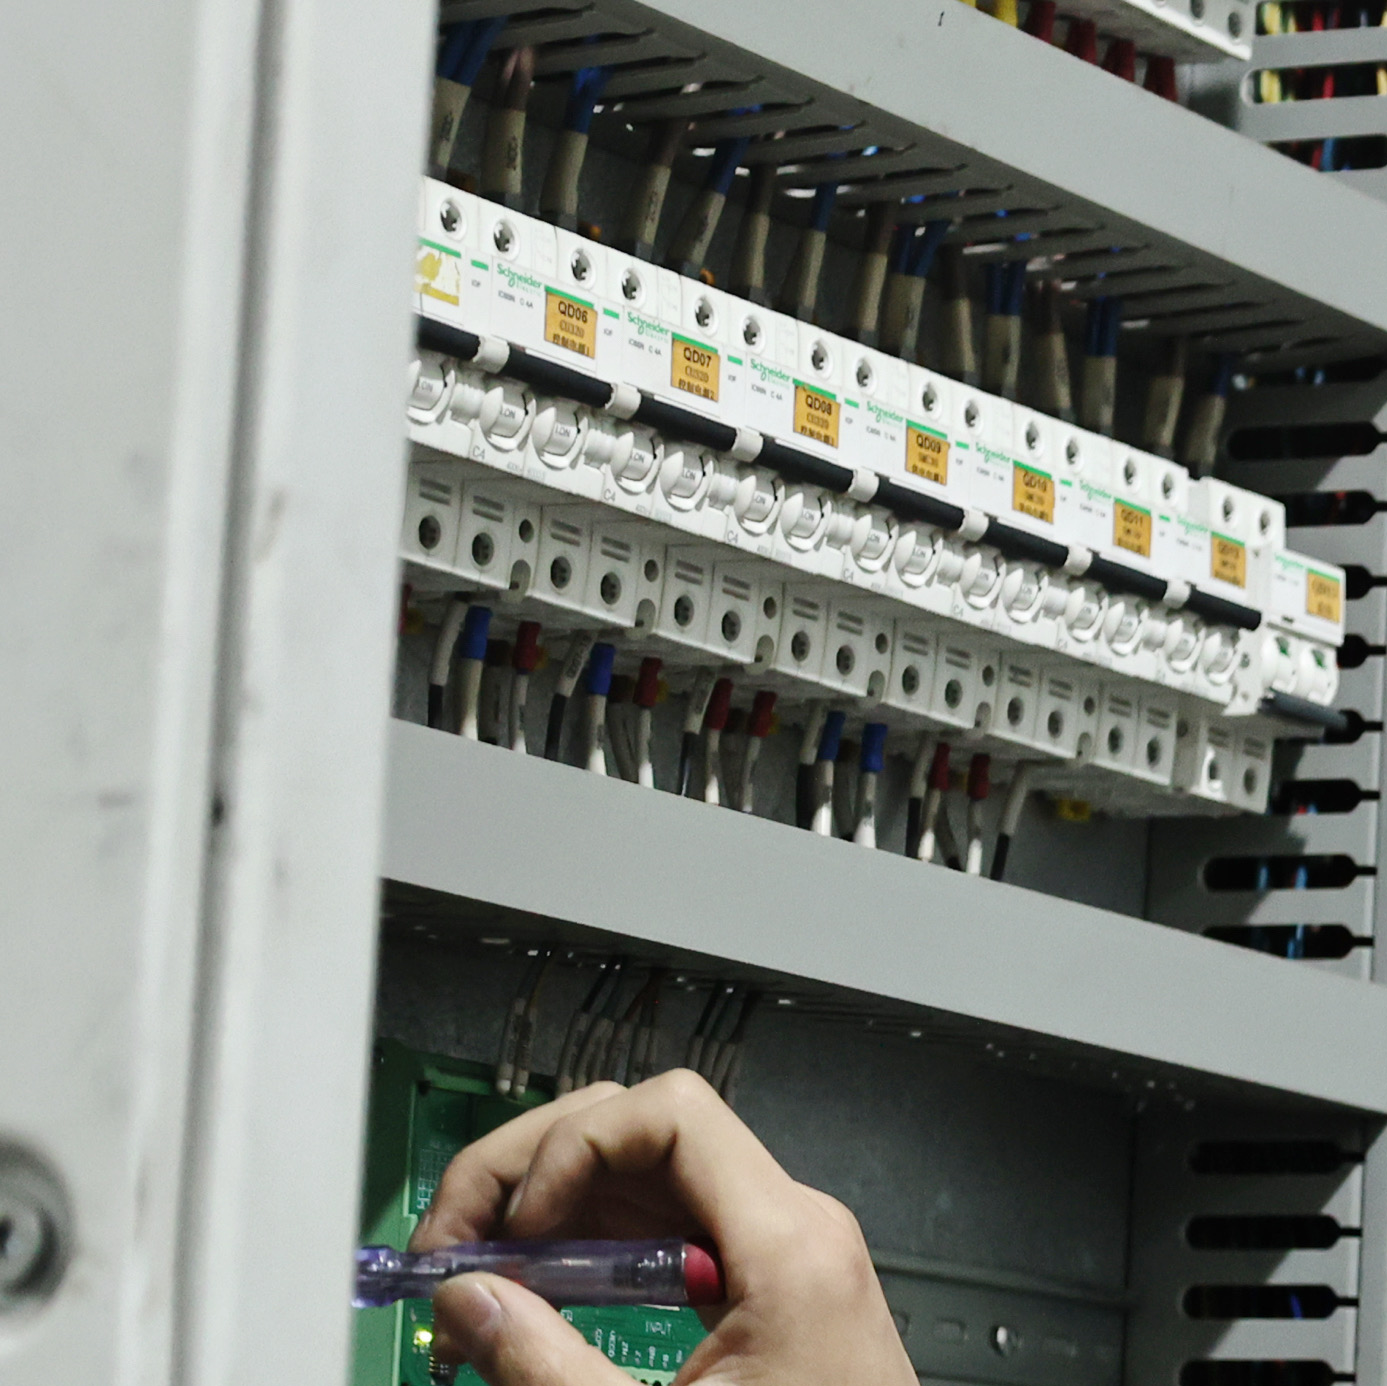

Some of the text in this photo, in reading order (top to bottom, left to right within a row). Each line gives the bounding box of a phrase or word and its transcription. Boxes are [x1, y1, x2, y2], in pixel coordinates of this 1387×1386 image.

[498, 263, 542, 288] Schneider
[557, 300, 588, 324] QD06
[628, 312, 670, 335] Schneider
[683, 347, 712, 368] QD07
[751, 358, 791, 381] Schneider
[805, 394, 832, 416] QD08
[472, 446, 485, 459] C4
[916, 433, 941, 454] QD09
[603, 489, 616, 502] C4
[727, 531, 738, 544] C4
